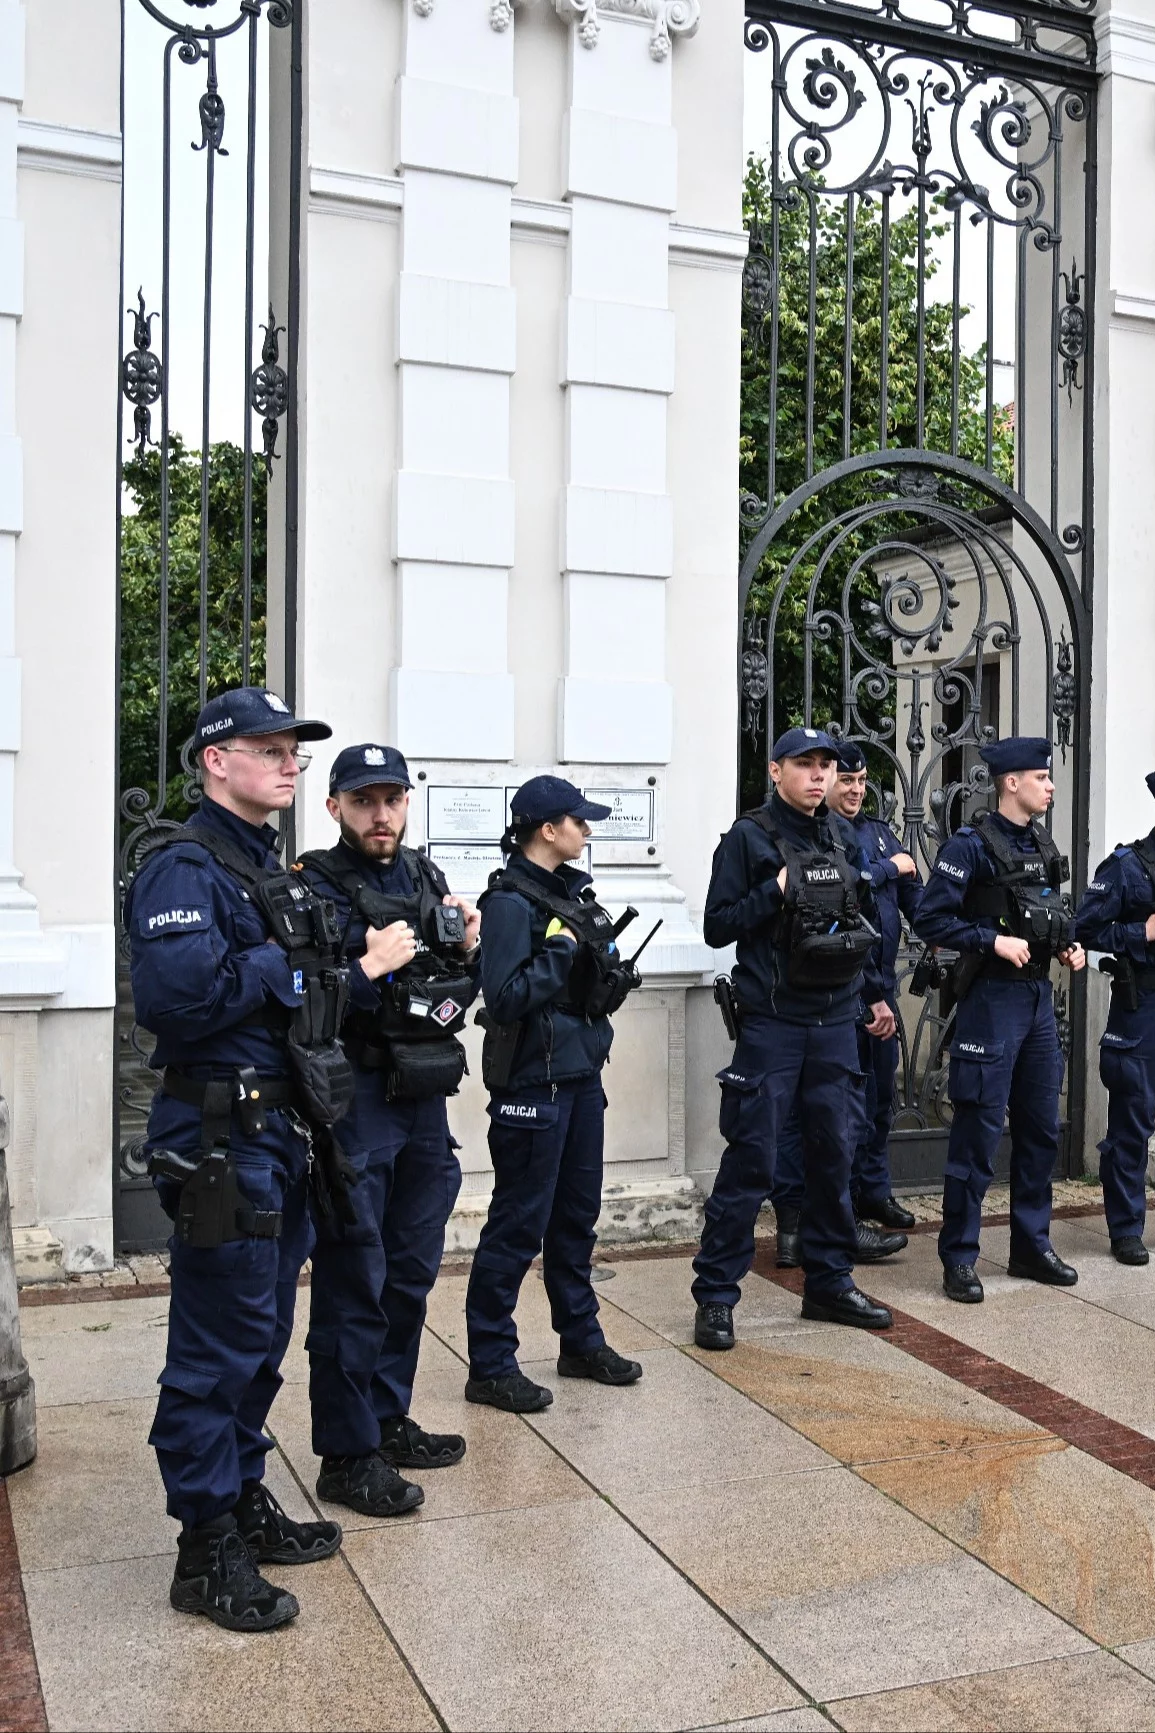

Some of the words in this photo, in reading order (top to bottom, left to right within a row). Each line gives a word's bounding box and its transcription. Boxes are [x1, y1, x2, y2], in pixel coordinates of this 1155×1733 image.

[201, 717, 234, 737] POLICJA
[807, 869, 840, 881] POLICJA
[938, 861, 965, 880] POLICJA
[149, 910, 202, 930] POLICJA
[959, 1043, 985, 1054] POLICJA
[500, 1104, 537, 1118] POLICJA
